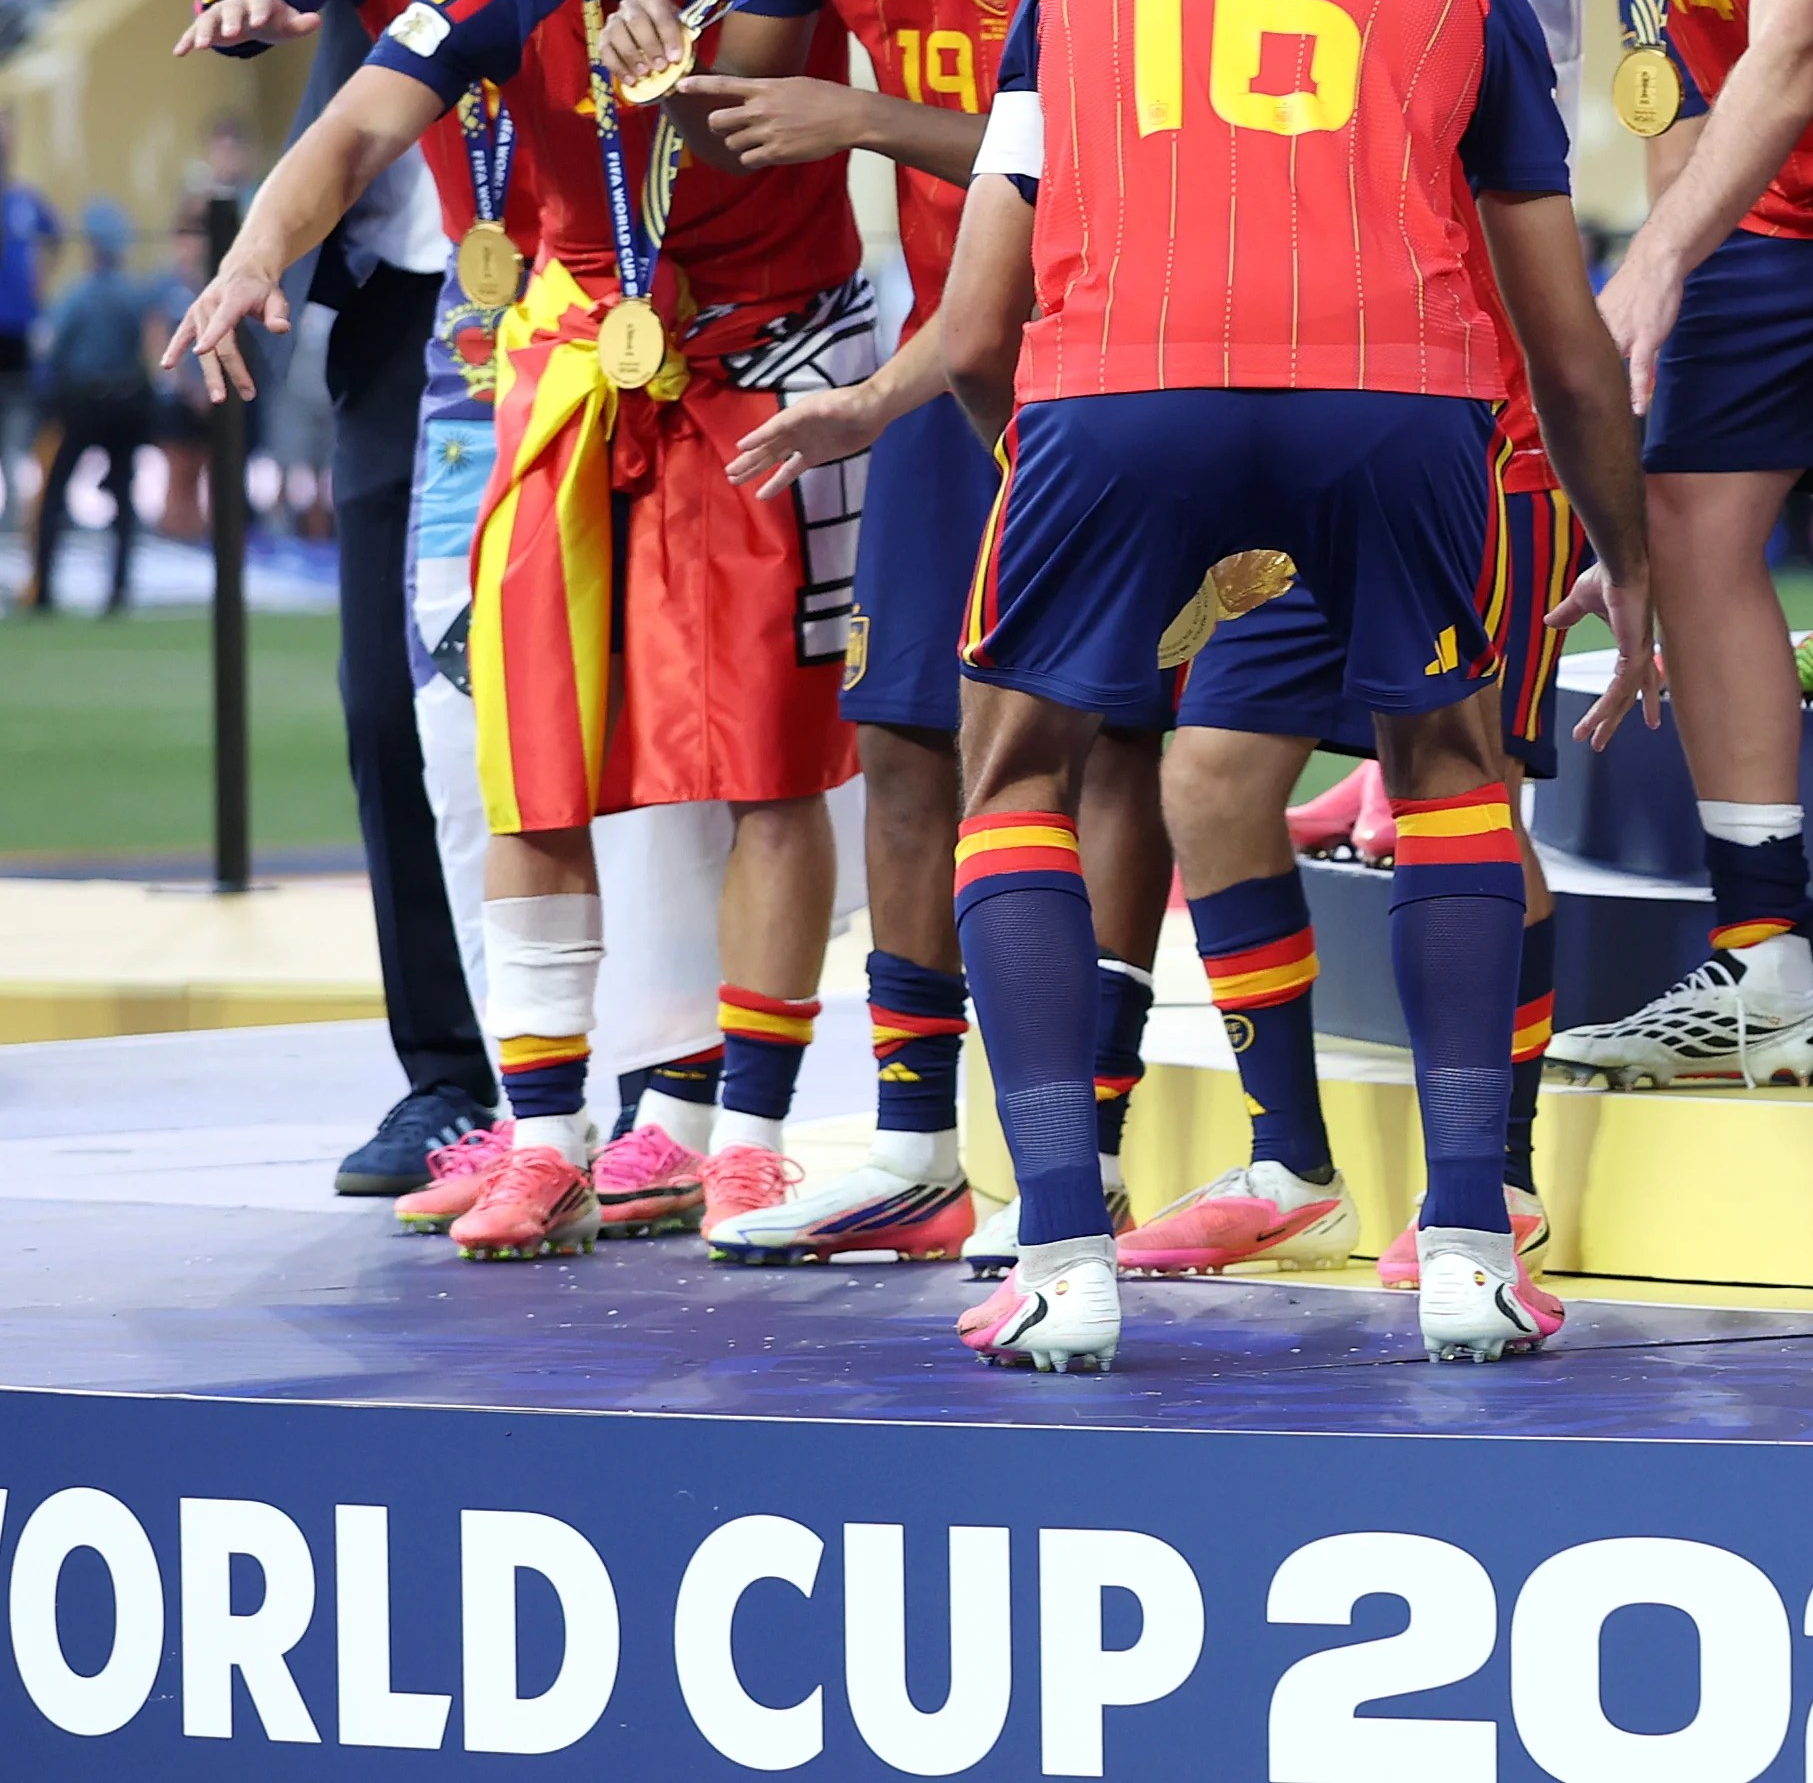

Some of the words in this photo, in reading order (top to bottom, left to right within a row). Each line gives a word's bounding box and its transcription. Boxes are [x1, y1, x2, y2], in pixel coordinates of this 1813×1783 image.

[896, 28, 980, 115] 19
[471, 149, 489, 186] FIFA
[606, 151, 624, 187] FIFA
[478, 185, 494, 220] WOR
[611, 189, 632, 248] WORLD
[620, 247, 637, 281] CUP
[0, 1485, 621, 1756] ORLD
[674, 1513, 1205, 1778] CUP
